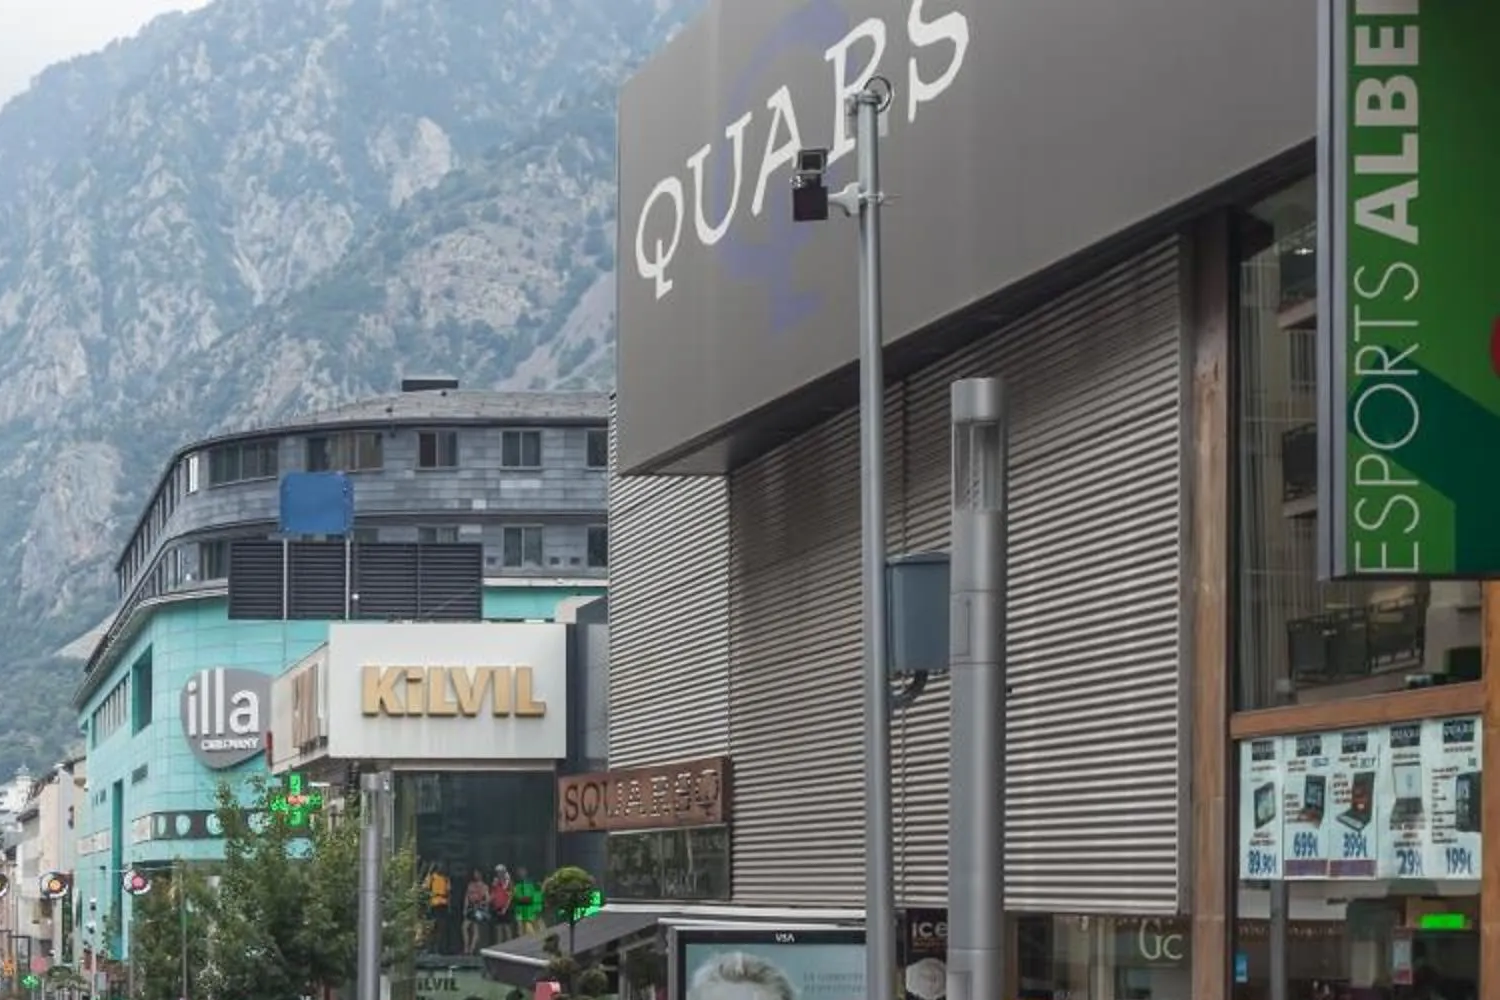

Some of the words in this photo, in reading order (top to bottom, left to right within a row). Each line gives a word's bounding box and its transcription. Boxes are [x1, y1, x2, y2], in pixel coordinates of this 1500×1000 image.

[635, 0, 970, 299] QUARS
[1354, 261, 1420, 573] ESPORTS
[187, 667, 260, 736] illa
